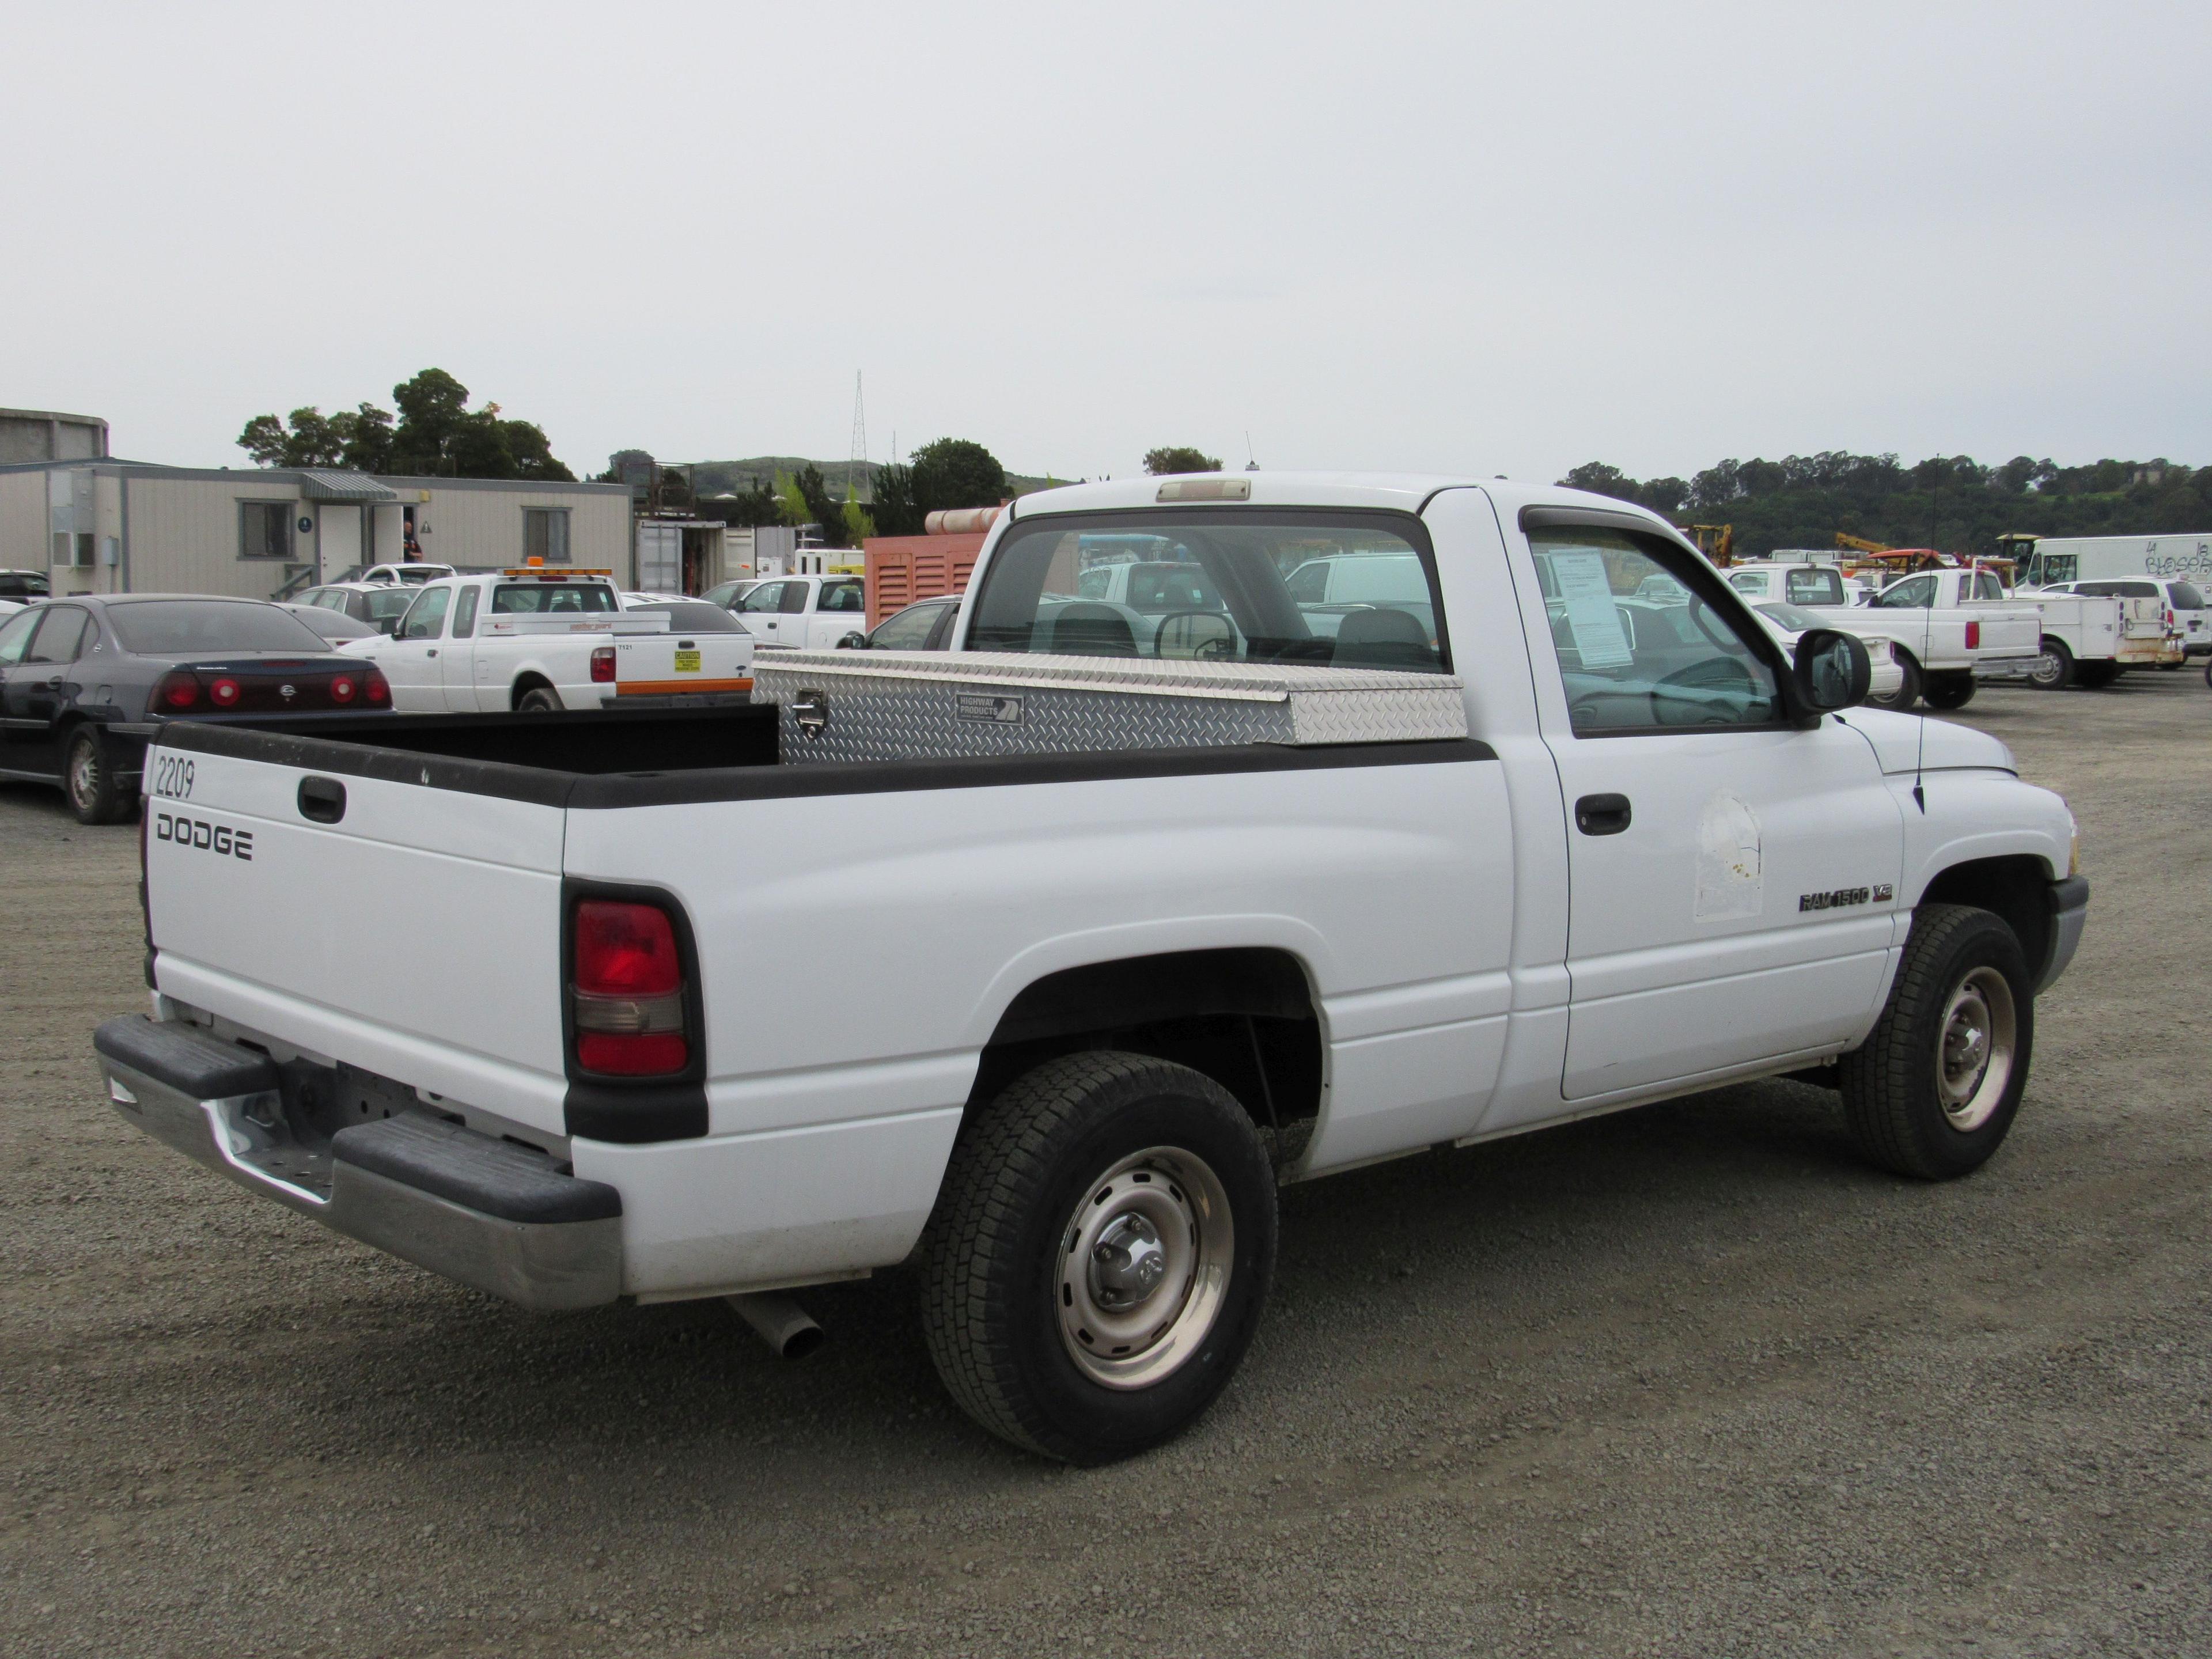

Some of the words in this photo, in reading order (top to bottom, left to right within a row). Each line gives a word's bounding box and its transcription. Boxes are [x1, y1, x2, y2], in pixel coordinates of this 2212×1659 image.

[960, 696, 995, 707] HIGHWAY
[960, 704, 998, 716] PRODUCTS
[156, 755, 195, 799] 2209
[157, 813, 253, 861] DODGE
[1800, 892, 1831, 912] RAM
[1834, 887, 1870, 907] 1500
